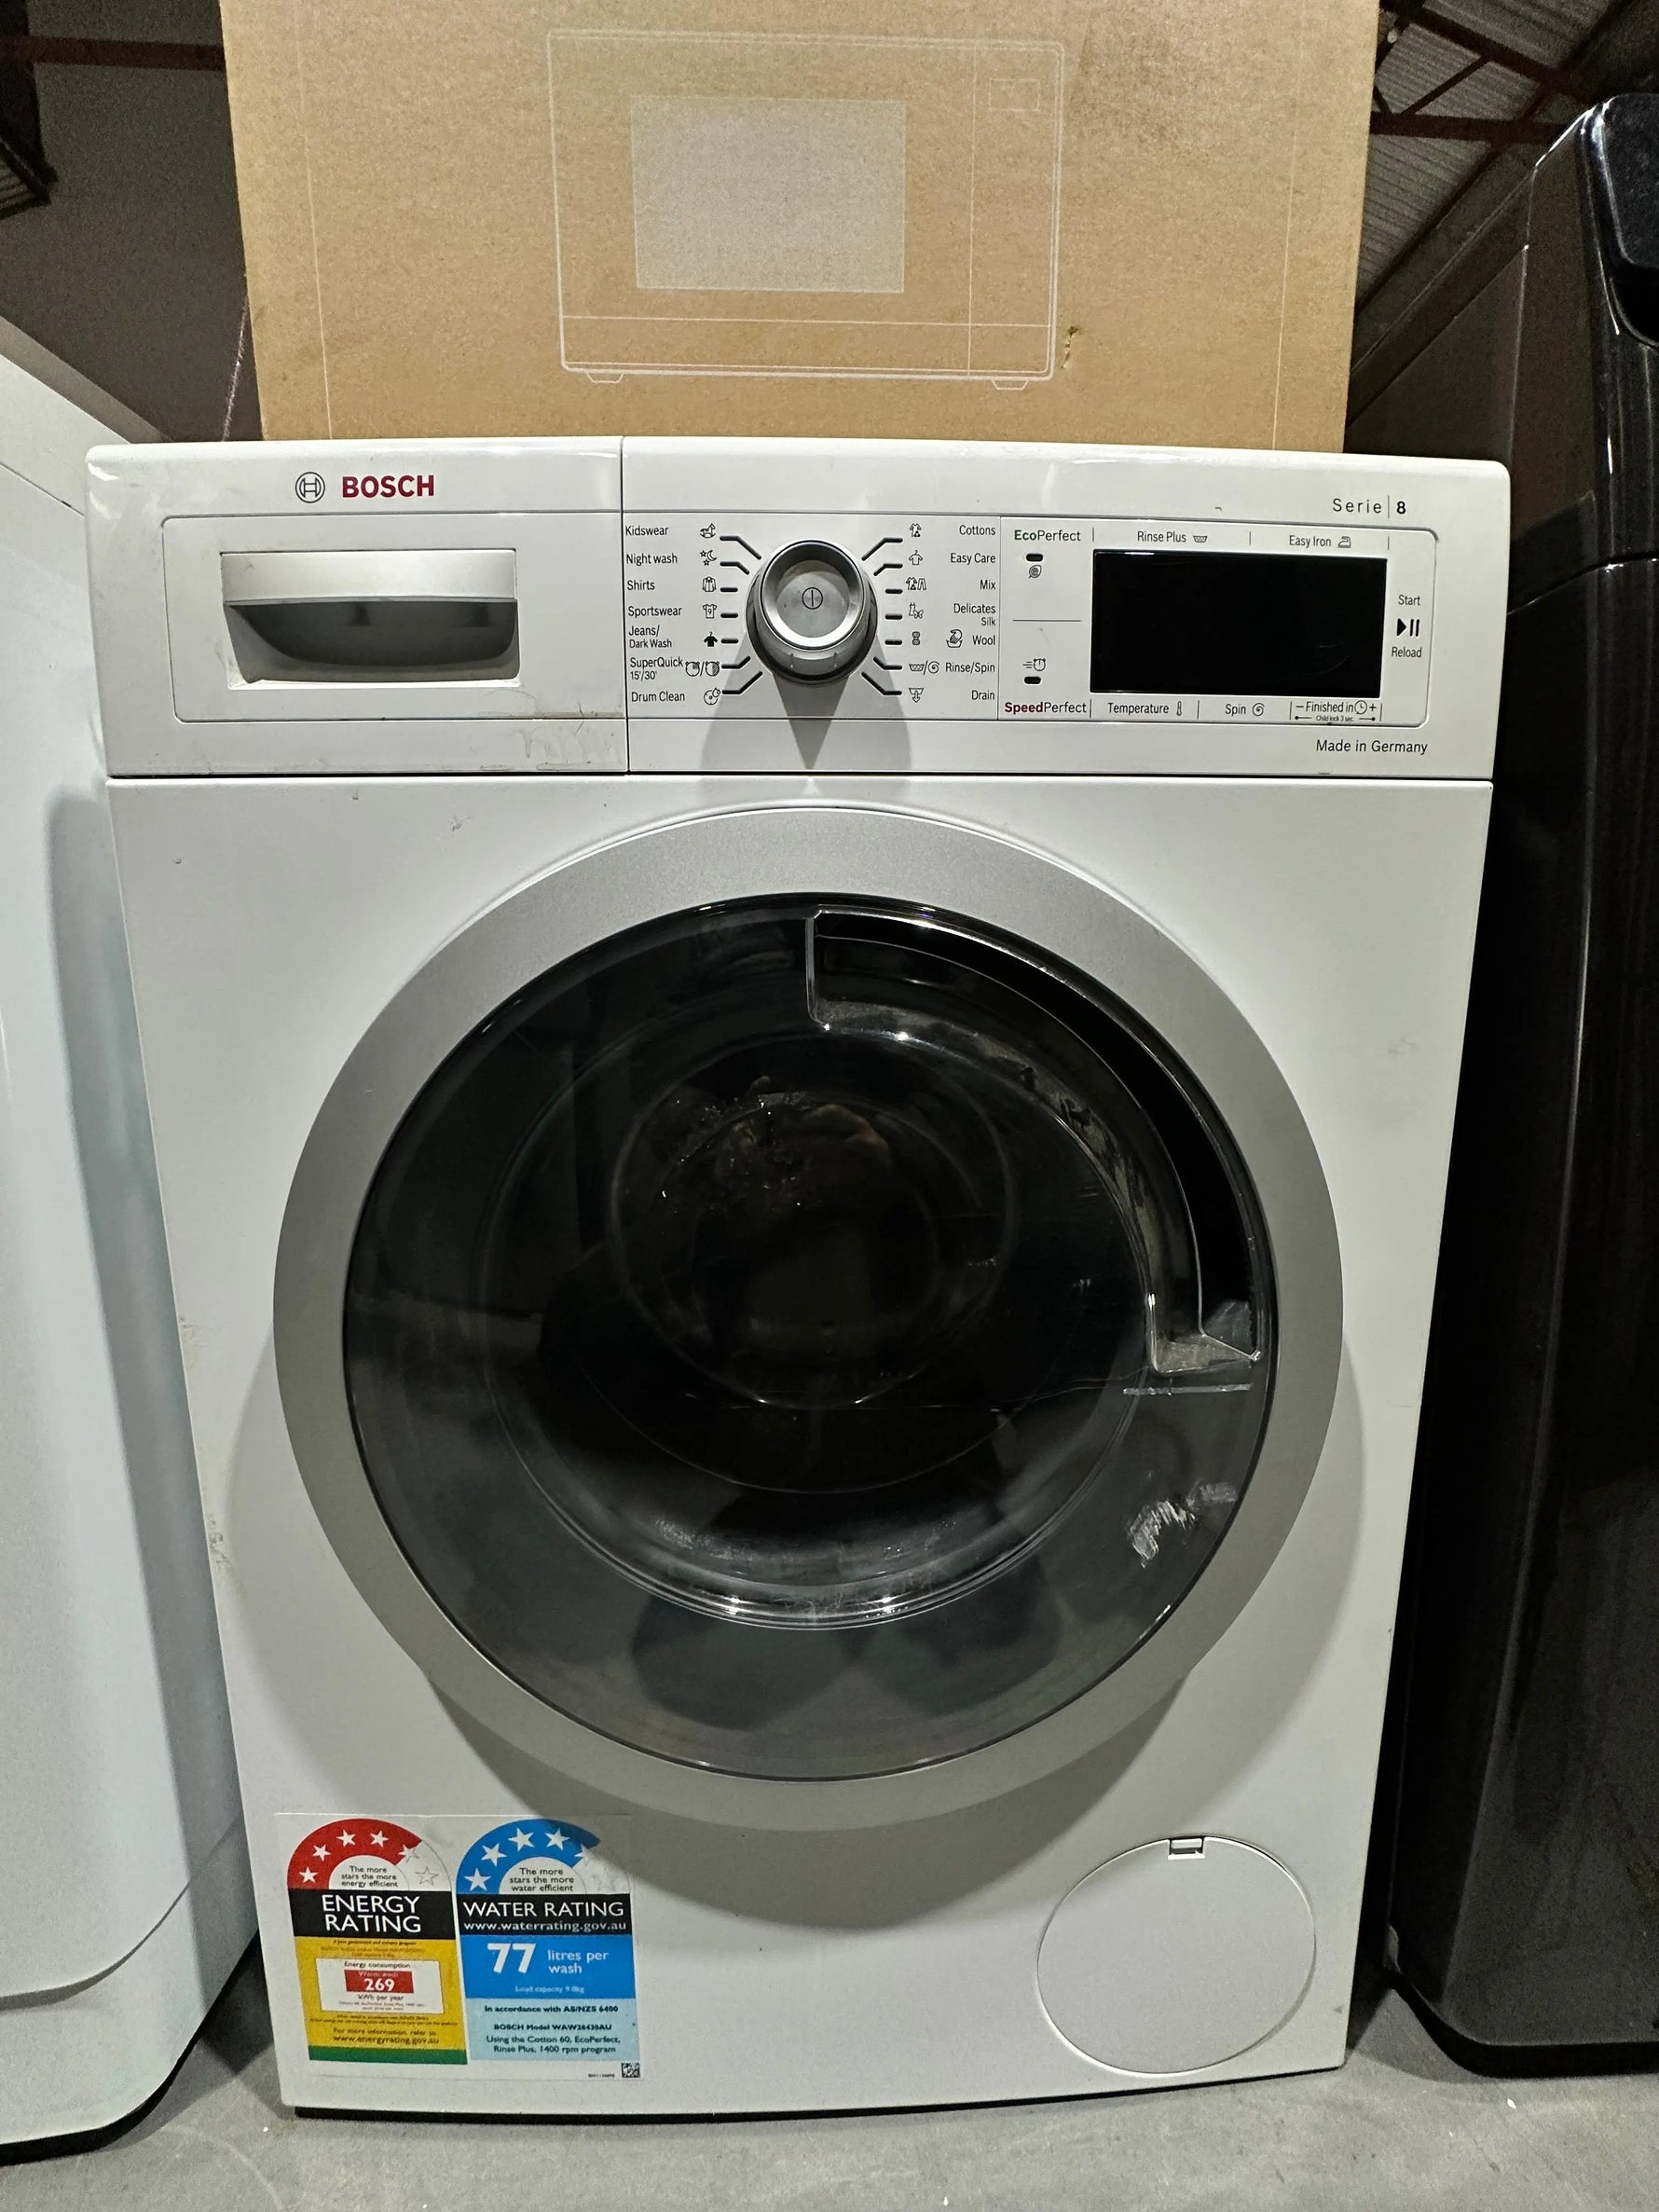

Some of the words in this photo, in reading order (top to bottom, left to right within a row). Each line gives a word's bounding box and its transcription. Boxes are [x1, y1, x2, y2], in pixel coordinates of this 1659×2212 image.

[342, 474, 435, 499] BOSCH
[1332, 499, 1382, 514] Serie
[1396, 501, 1406, 515] 8
[624, 525, 669, 536] Kidswear
[958, 524, 996, 536] Cottons
[1013, 529, 1081, 542] EcoPerfect
[1137, 530, 1164, 543] Rinse
[1166, 531, 1186, 543] Plus
[1289, 535, 1310, 548] Easy
[1312, 536, 1332, 547] Iron
[626, 554, 651, 566] Night
[653, 554, 679, 564] wash
[950, 553, 973, 566] Easy
[974, 553, 996, 564] Care
[626, 579, 655, 591] Shirts
[980, 579, 996, 590] Mix
[1397, 595, 1420, 606] Start
[627, 605, 682, 618] Sportswear
[953, 602, 996, 614] Delicates
[980, 616, 996, 626] Silk
[628, 625, 660, 638] Jeans/
[629, 639, 649, 649] Dark
[650, 639, 672, 649] Wash
[972, 635, 996, 646] Wool
[1391, 647, 1422, 659] Reload
[629, 655, 684, 670] SuperQuick
[945, 662, 995, 675] Rinse/Spin
[631, 692, 657, 702] Drum
[658, 691, 685, 702] Clean
[971, 690, 995, 701] Drain
[1005, 701, 1088, 715] SpeedPerfect
[1107, 702, 1169, 717] Temperature
[1226, 704, 1246, 716] Spin
[1306, 701, 1344, 712] Finished
[1345, 701, 1354, 713] in
[1316, 739, 1351, 752] Made
[1355, 739, 1366, 752] in
[1371, 739, 1429, 755] Germany
[519, 1867, 538, 1875] The
[533, 1875, 551, 1884] the
[540, 1884, 574, 1892] efficient
[321, 1894, 421, 1914] ENERGY
[462, 1902, 537, 1917] WATER
[544, 1902, 624, 1917] RATING
[324, 1914, 422, 1933] RATING
[463, 1920, 627, 1932] www.waterrating.gov.au
[487, 1943, 536, 1974] 77
[547, 1949, 582, 1962] litres
[586, 1950, 610, 1963] per
[344, 1960, 366, 1969] Energy
[368, 1961, 411, 1970] consumption
[548, 1962, 583, 1974] wash
[363, 1978, 395, 1992] 269
[534, 1985, 564, 1994] capacity
[494, 2005, 542, 2013] accordance
[542, 2005, 562, 2013] with
[563, 2005, 597, 2013] AS/NZS
[598, 2005, 619, 2013] 6400
[333, 2035, 440, 2045] www.energyrating.gov.au
[486, 2035, 510, 2044] Using
[527, 2036, 557, 2044] Cotton
[559, 2036, 572, 2044] 60,
[574, 2036, 621, 2044] EcoPerfect,
[517, 2045, 537, 2054] Plus,
[561, 2046, 579, 2054] rpm
[581, 2046, 616, 2054] program
